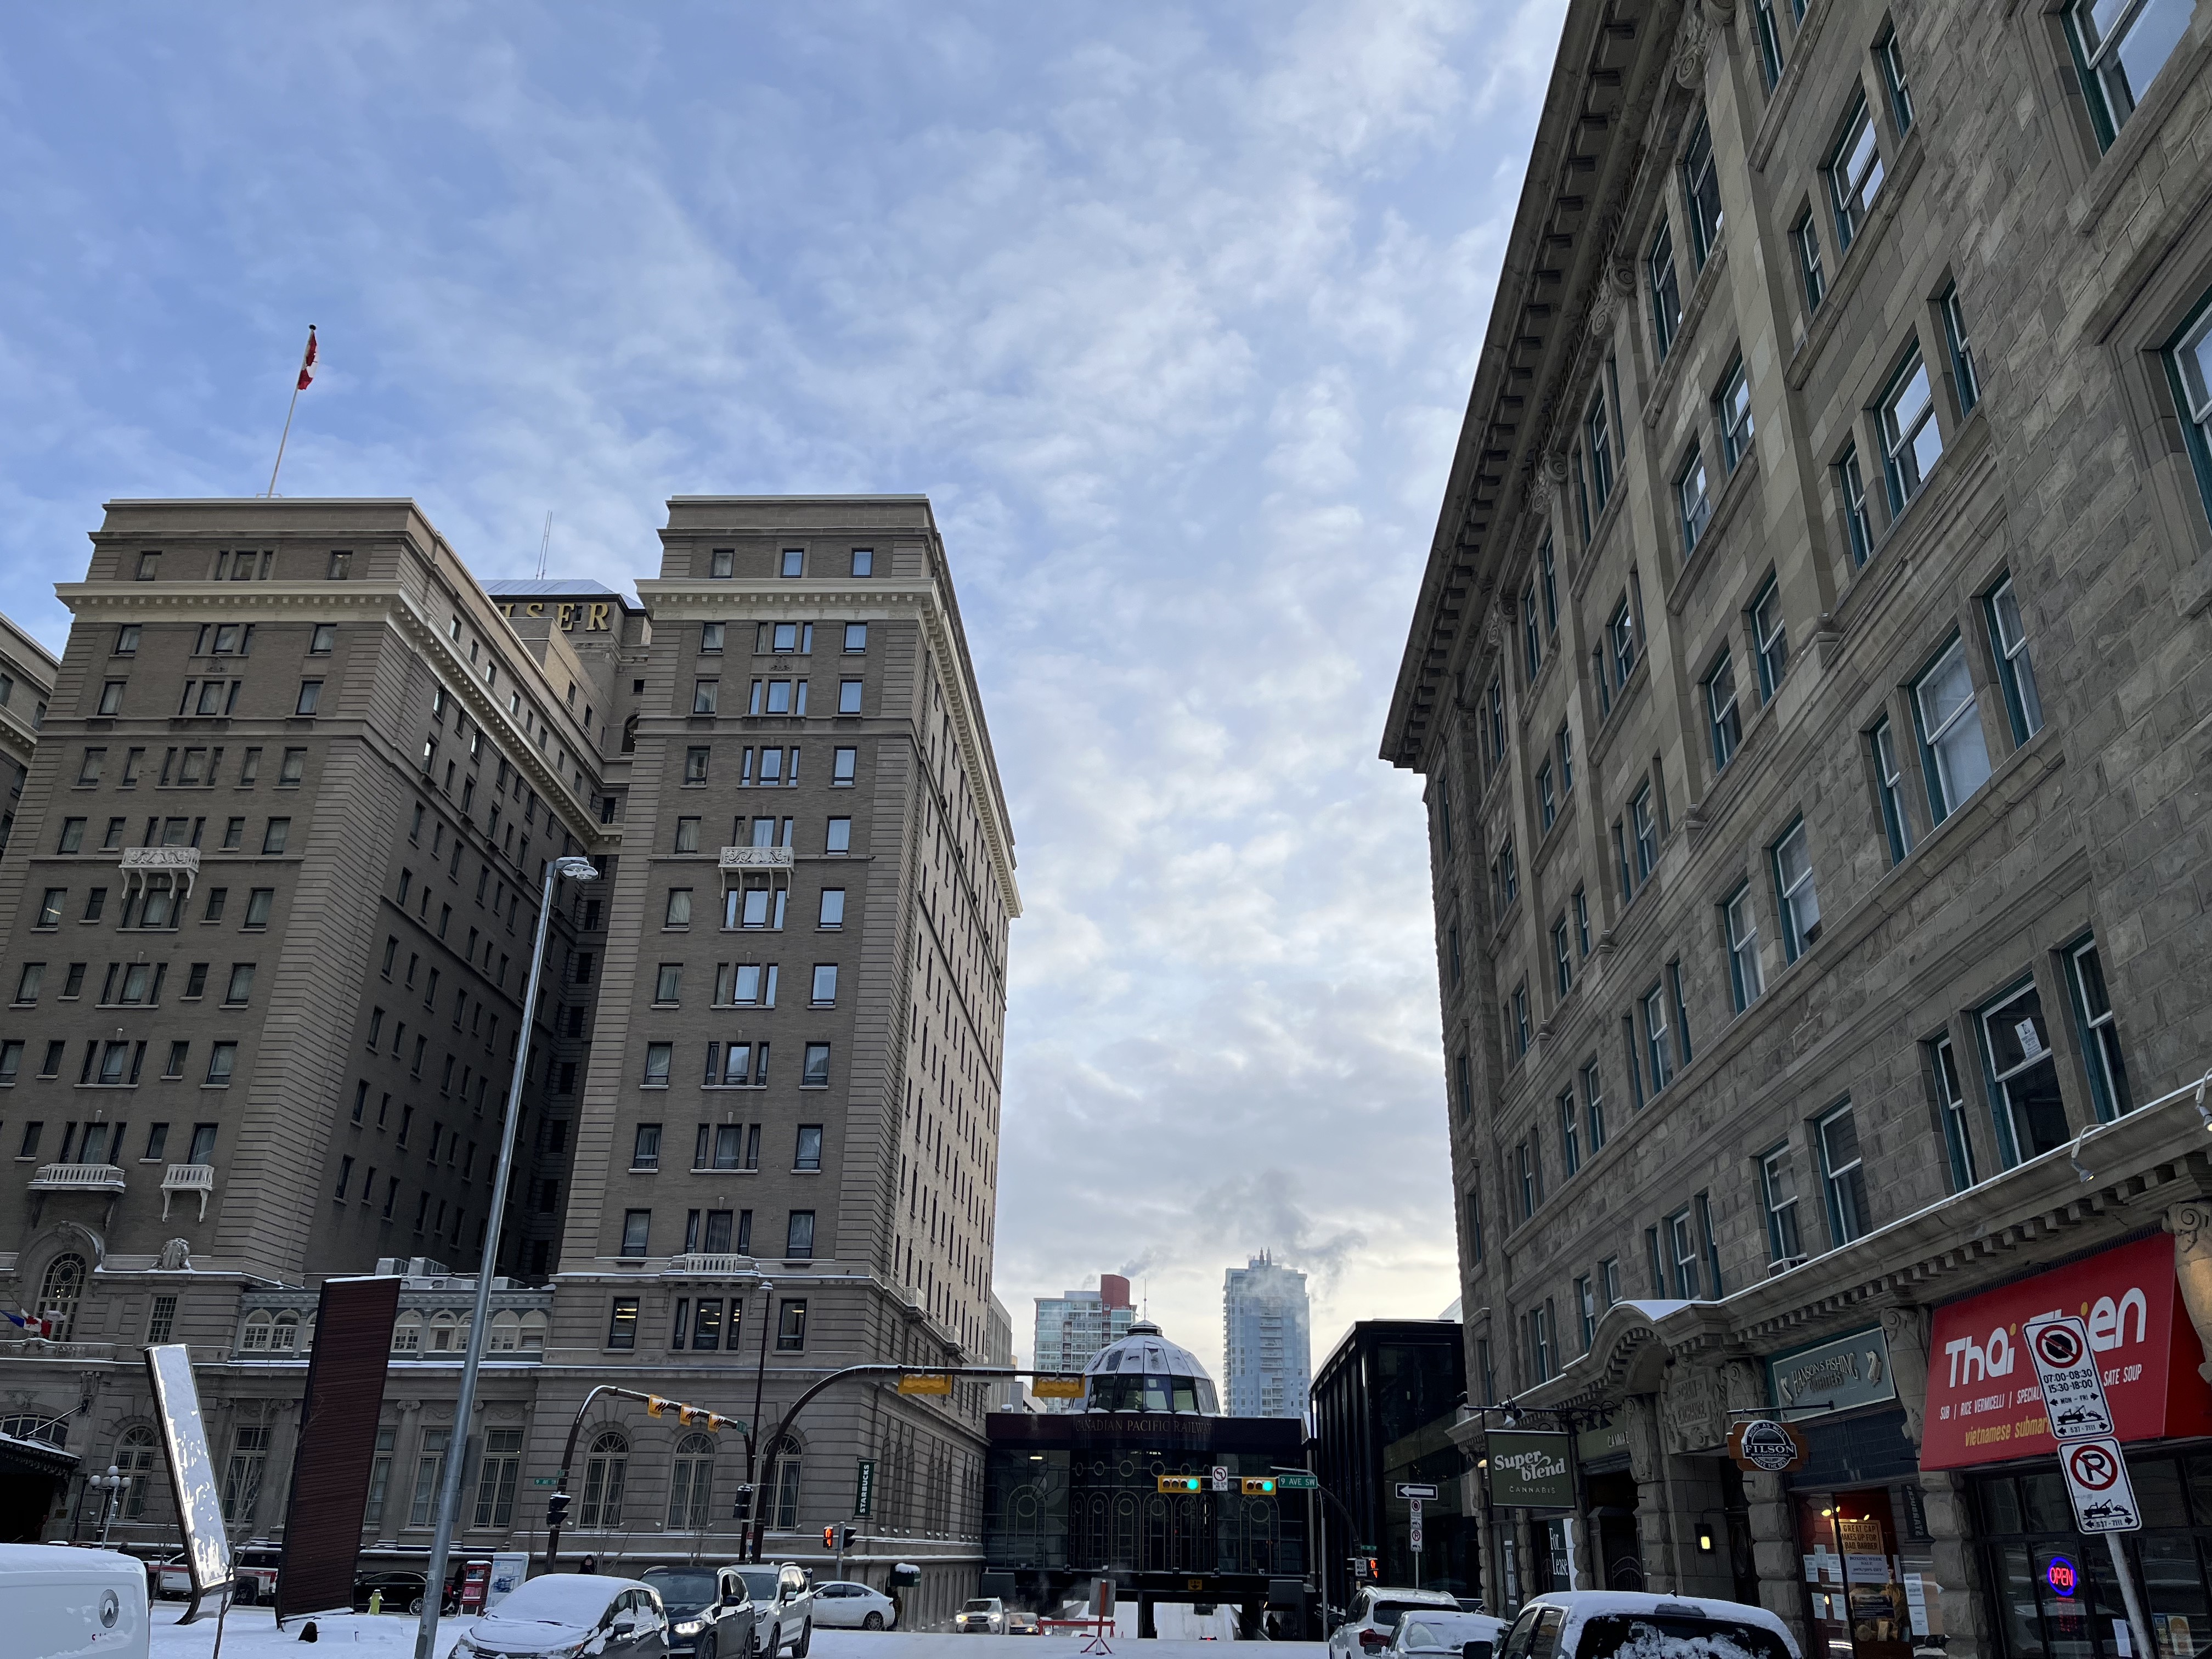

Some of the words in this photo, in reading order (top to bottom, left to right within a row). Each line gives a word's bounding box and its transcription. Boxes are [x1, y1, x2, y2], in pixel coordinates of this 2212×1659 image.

[1825, 1352, 1858, 1379] FISHING
[1945, 1322, 2017, 1388] Thai
[1940, 1405, 1950, 1420] SUB
[1960, 1401, 1972, 1417] RICE
[1974, 1393, 2005, 1414] VERMICELLI
[2103, 1368, 2120, 1387] SATE
[2123, 1364, 2143, 1383] SOUP
[1075, 1420, 1123, 1432] CANADIAN
[1127, 1420, 1171, 1432] PACIFIC
[1173, 1420, 1211, 1434] RAILWAY
[1773, 1425, 1786, 1438] WELL
[1965, 1423, 2011, 1447] vietnamese
[1745, 1444, 1794, 1453] FILSON
[1494, 1451, 1542, 1471] Super
[1521, 1456, 1567, 1482] blend
[859, 1464, 870, 1514] STARBUCKS
[1509, 1486, 1556, 1494] CANNABIS
[1549, 1528, 1559, 1550] For
[1551, 1553, 1568, 1576] Lease
[2050, 1567, 2073, 1586] OPEN
